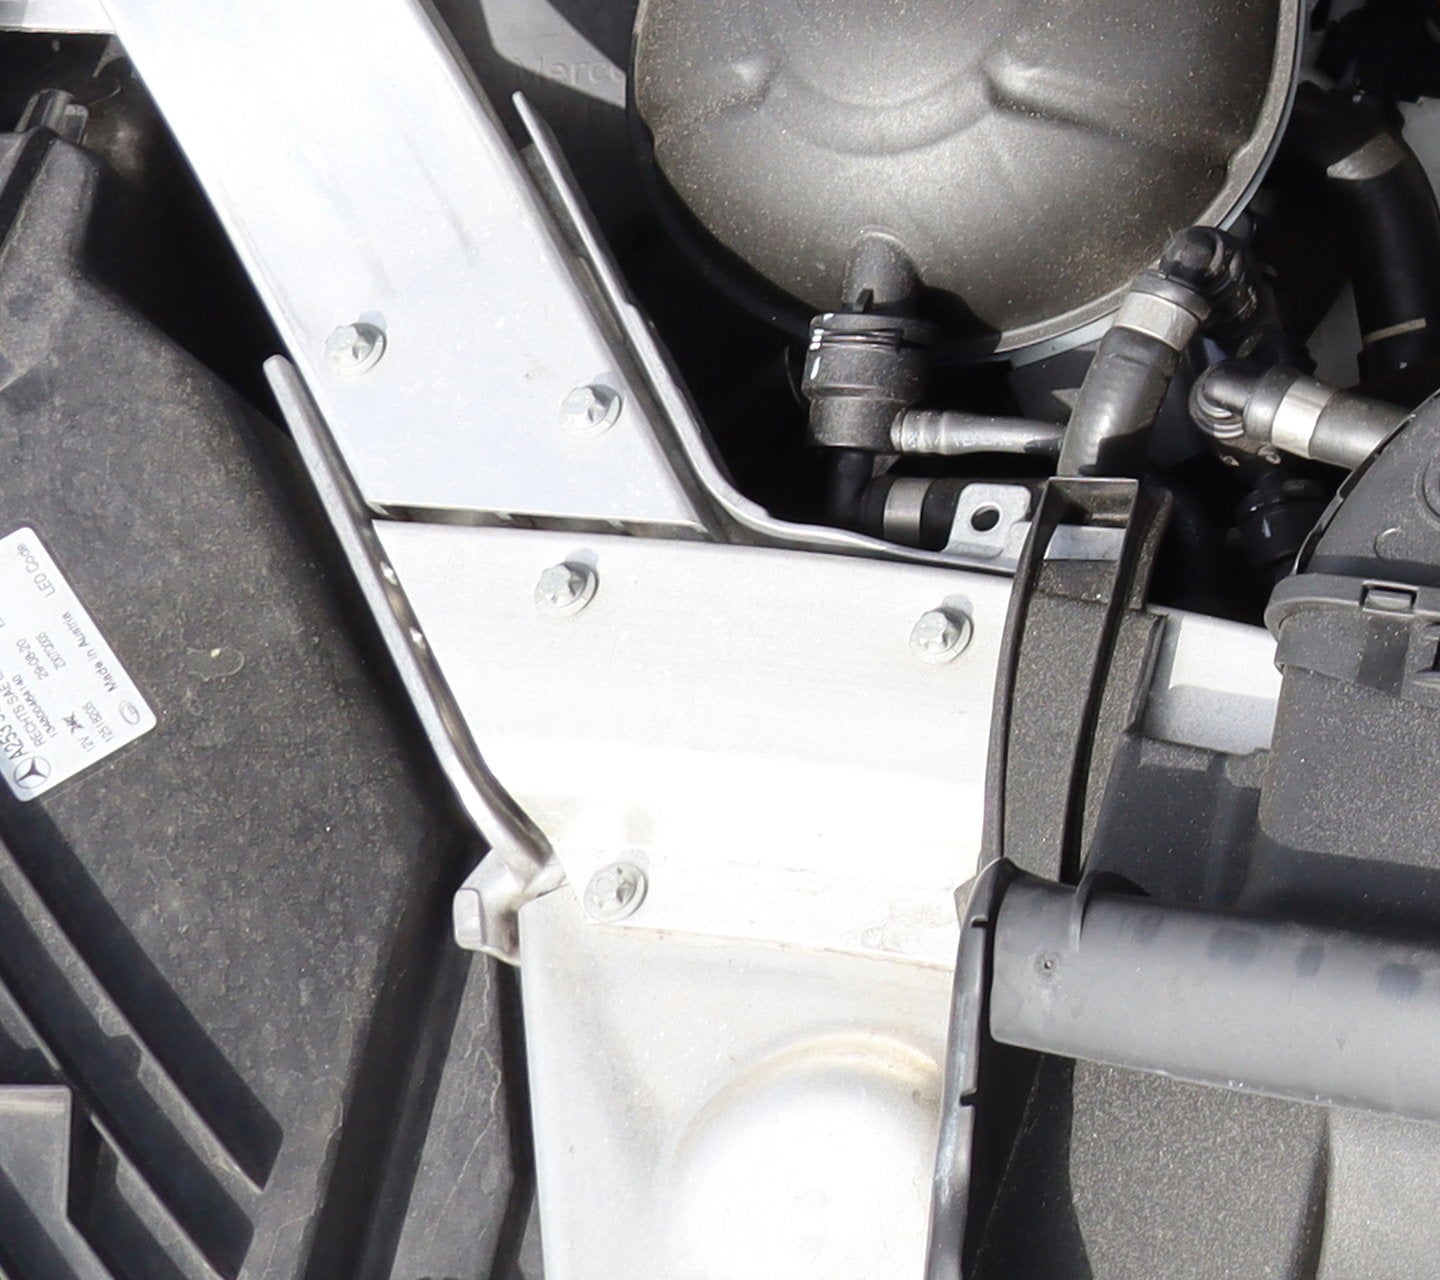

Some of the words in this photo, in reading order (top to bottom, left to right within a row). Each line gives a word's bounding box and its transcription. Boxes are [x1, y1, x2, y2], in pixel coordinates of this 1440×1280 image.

[12, 541, 40, 574] Code
[32, 570, 56, 598] LED
[58, 610, 90, 650] Austria
[91, 659, 119, 693] Made
[11, 703, 45, 748] RECHTS
